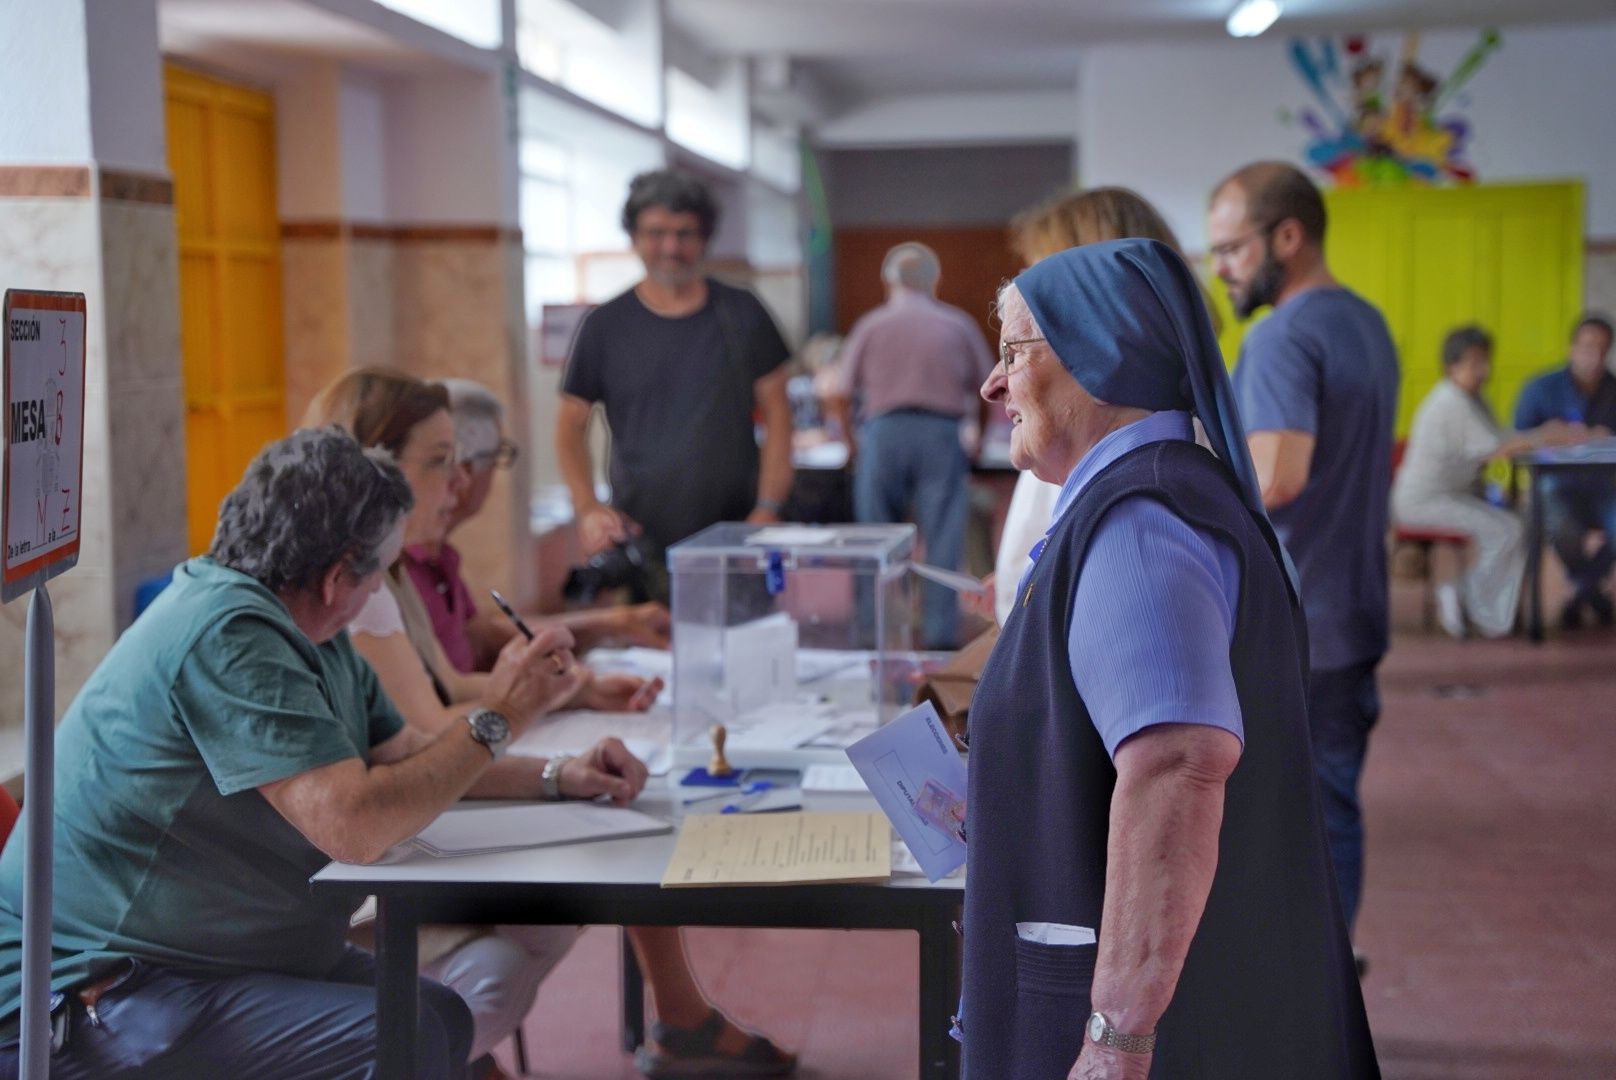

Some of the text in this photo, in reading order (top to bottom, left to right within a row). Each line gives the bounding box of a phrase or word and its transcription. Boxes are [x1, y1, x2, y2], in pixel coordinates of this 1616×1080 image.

[11, 314, 67, 376] SECCIÓN 3
[11, 399, 46, 445] MESA
[8, 544, 14, 560] De
[20, 539, 31, 554] letra
